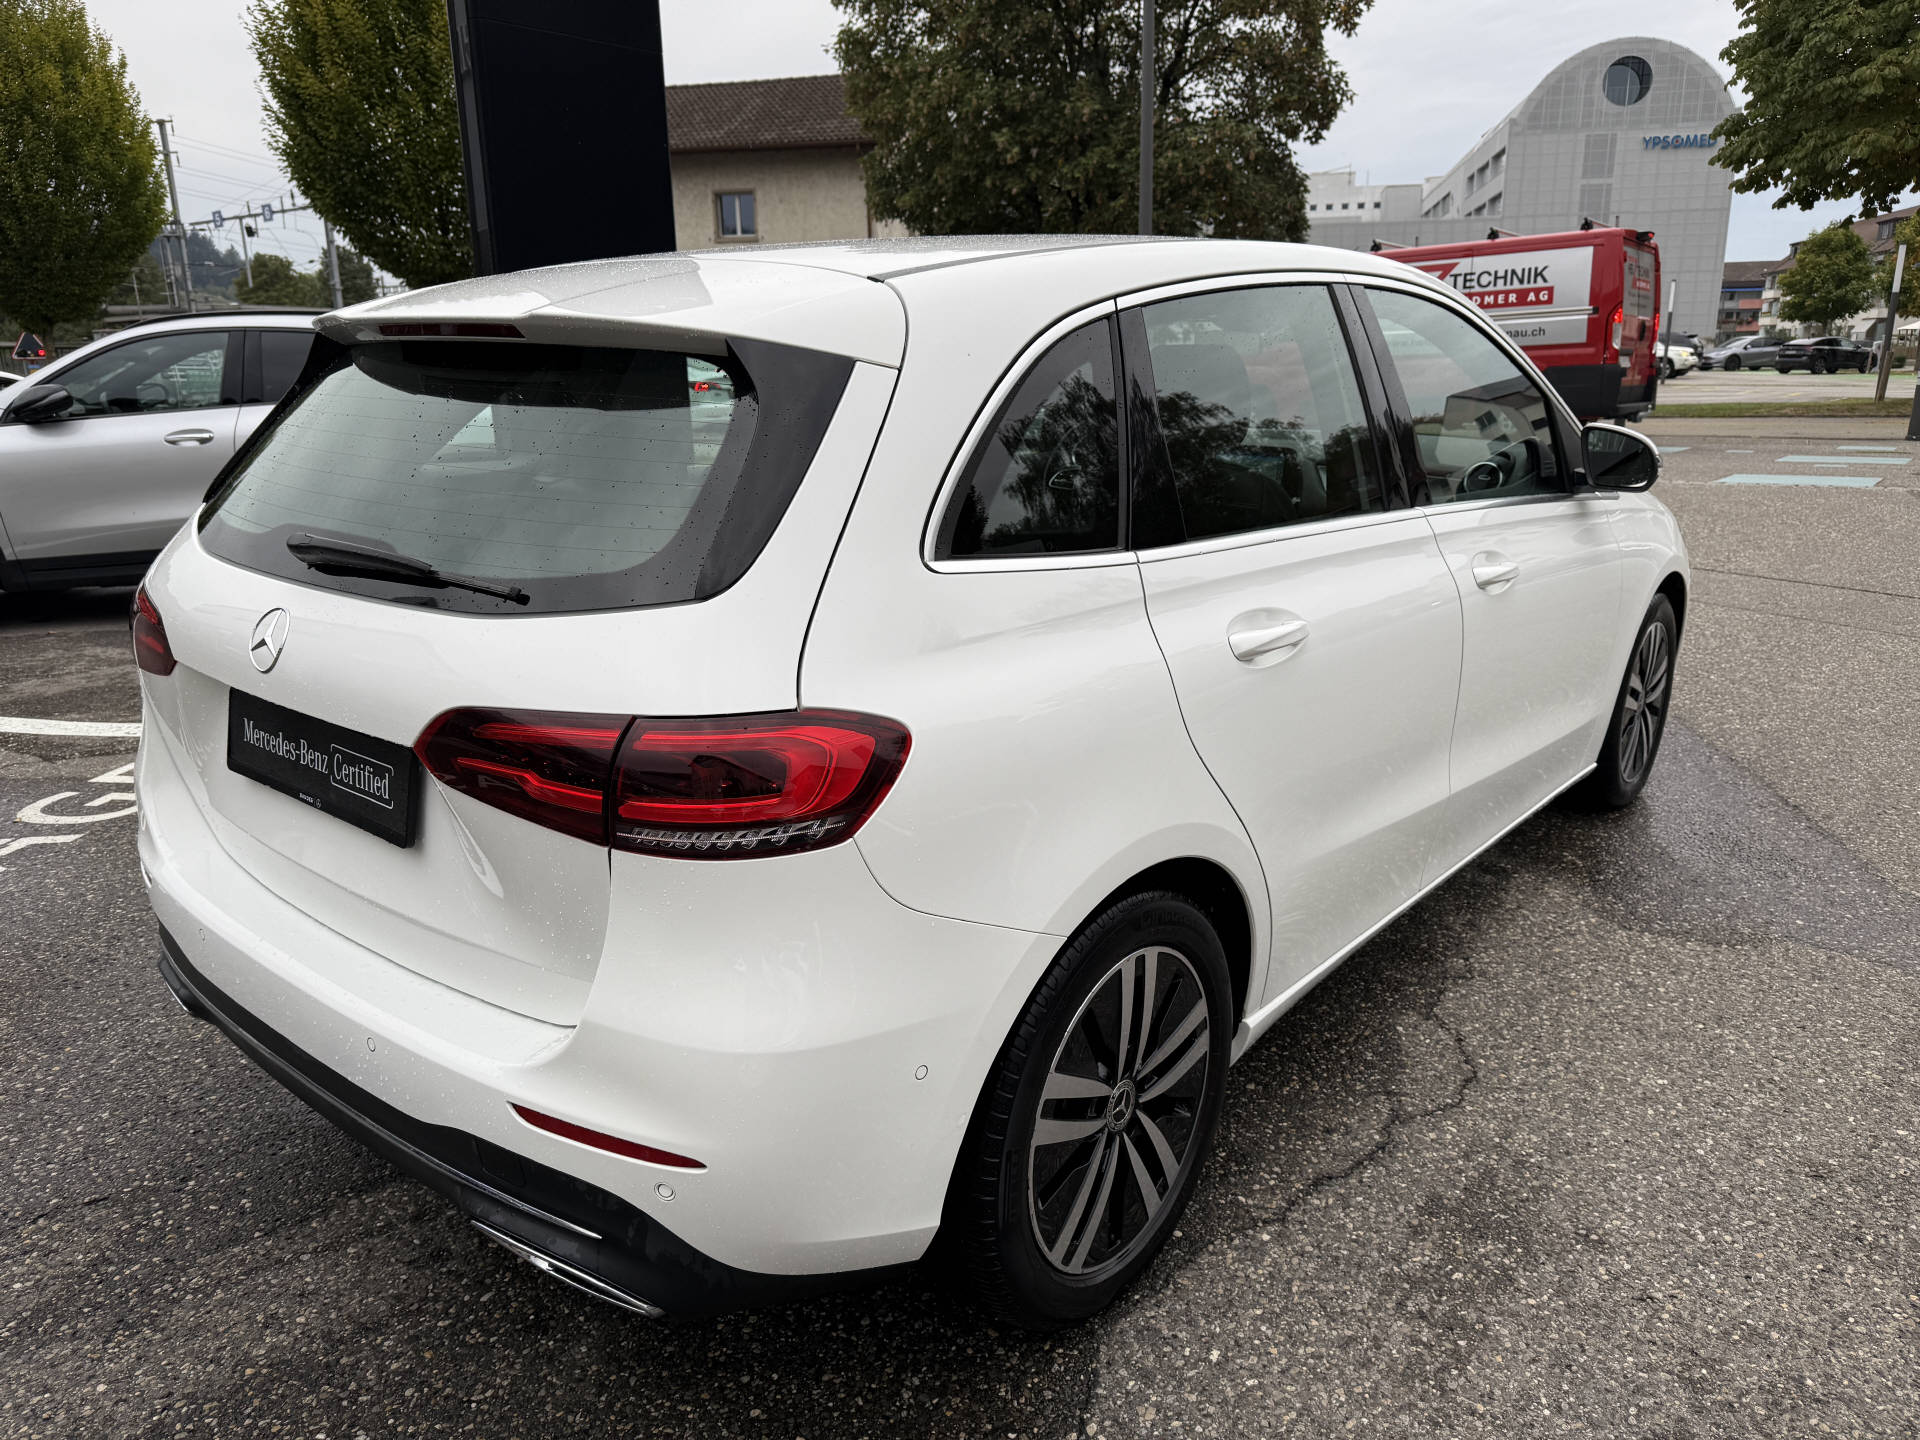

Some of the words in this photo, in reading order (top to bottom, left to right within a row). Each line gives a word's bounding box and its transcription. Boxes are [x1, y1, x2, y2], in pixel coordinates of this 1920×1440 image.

[1642, 134, 1718, 150] YPSOMED
[1527, 290, 1549, 302] AG
[242, 717, 329, 774] Mercedes-Benz
[333, 753, 390, 800] Certified
